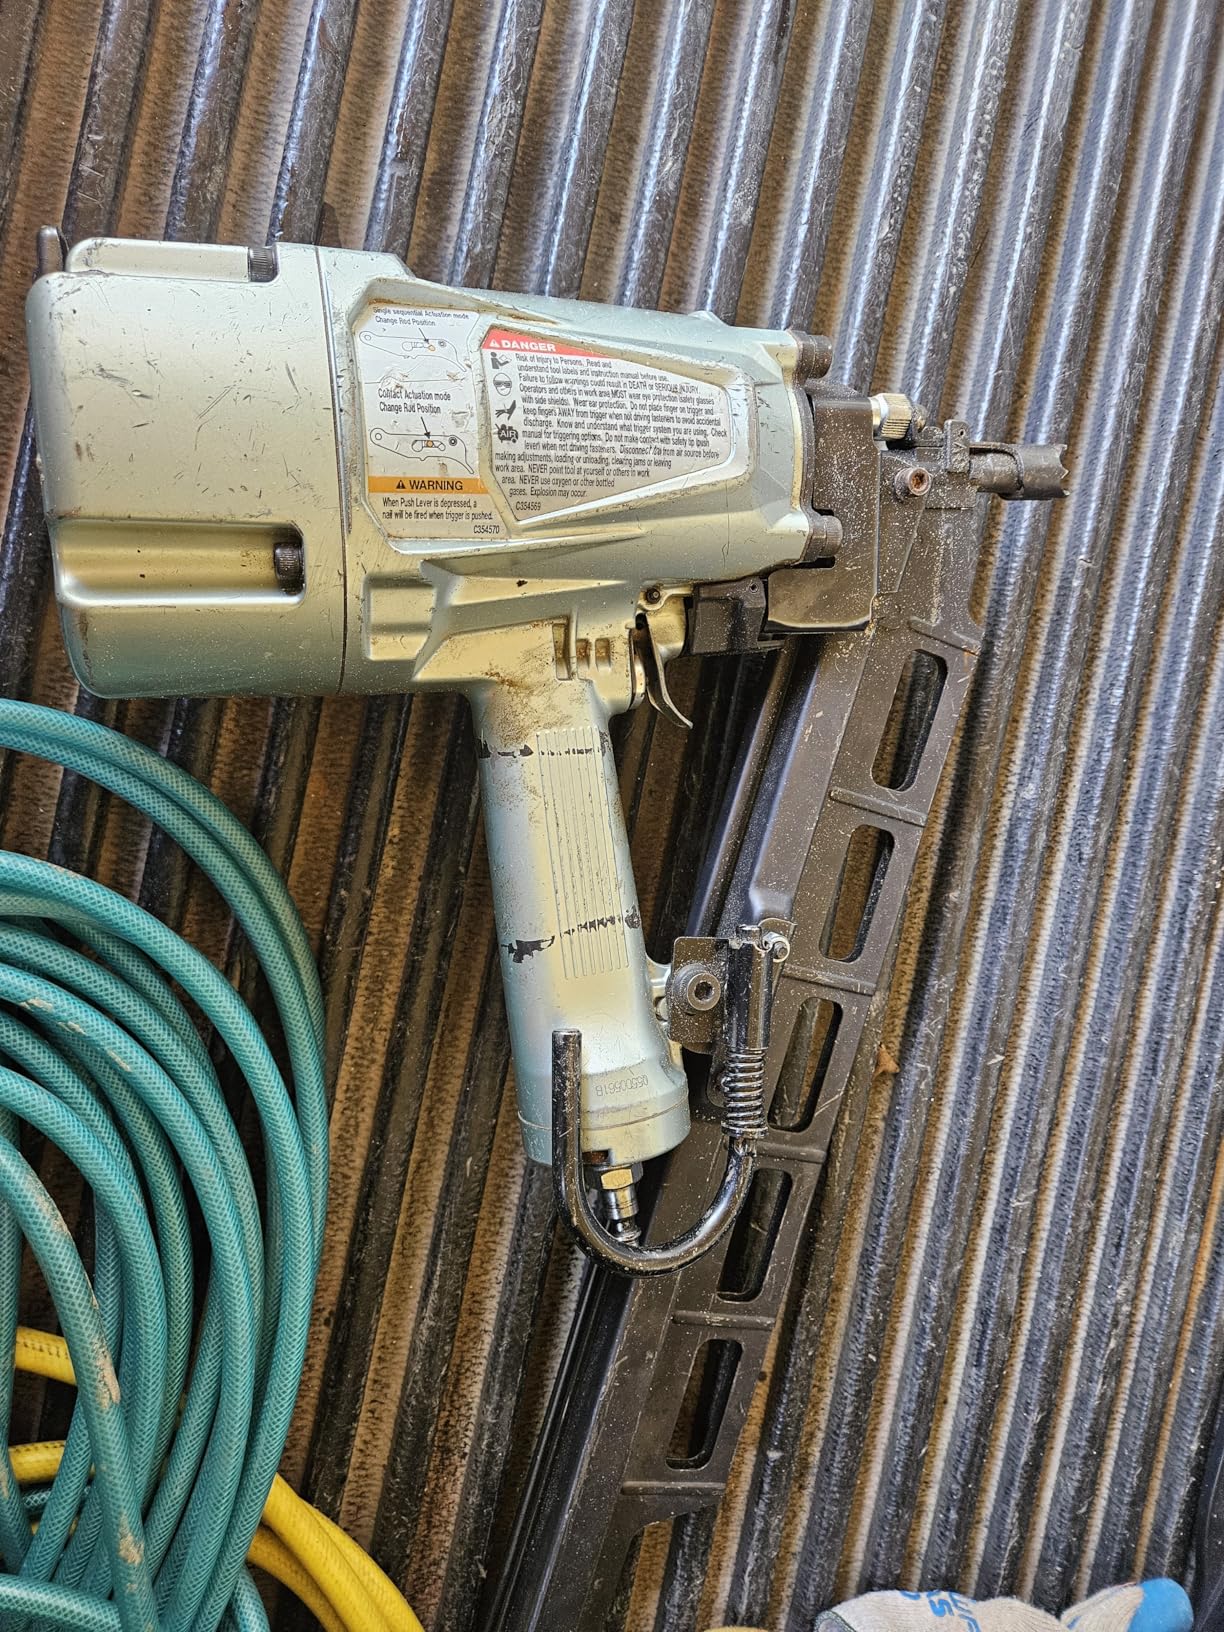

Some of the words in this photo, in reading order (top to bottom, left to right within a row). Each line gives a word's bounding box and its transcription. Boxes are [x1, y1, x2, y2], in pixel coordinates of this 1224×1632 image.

[373, 307, 391, 315] Single
[393, 309, 423, 317] sequential
[425, 310, 453, 318] Actuation
[375, 316, 397, 325] Change
[400, 317, 411, 325] Rod
[412, 318, 435, 326] Position
[501, 340, 556, 352] DANGER
[516, 353, 528, 361] Risk
[536, 354, 552, 364] Injury
[560, 357, 584, 366] Persons.
[586, 359, 600, 367] Read
[518, 365, 549, 373] understand
[550, 366, 560, 374] tool
[591, 370, 619, 378] instruction
[519, 373, 538, 382] Failure
[546, 375, 563, 384] follow
[564, 377, 589, 387] warnings
[590, 378, 605, 386] could
[606, 380, 622, 388] result
[629, 381, 647, 389] DEATH
[378, 388, 403, 399] Contact
[405, 390, 433, 400] Actuation
[434, 392, 451, 400] mode
[520, 383, 547, 394] Operators
[548, 385, 558, 393] and
[560, 386, 577, 395] others
[584, 388, 597, 396] work
[611, 389, 627, 399] MUST
[629, 392, 641, 400] wear
[642, 393, 651, 401] eye
[653, 392, 678, 402] protection
[696, 397, 714, 406] glasses
[379, 402, 402, 414] Change
[404, 403, 415, 413] Rod
[417, 403, 441, 414] Position
[522, 396, 534, 404] with
[535, 396, 546, 404] side
[573, 398, 589, 406] Wear
[599, 401, 628, 410] protection.
[649, 403, 662, 413] place
[664, 403, 678, 414] finger
[687, 405, 703, 416] trigger
[704, 407, 714, 415] and
[523, 405, 537, 415] keep
[538, 406, 556, 416] fingers
[558, 408, 574, 416] AWAY
[576, 409, 588, 417] from
[590, 410, 607, 421] trigger
[608, 411, 623, 420] when
[633, 412, 650, 424] driving
[652, 413, 674, 423] fasteners
[682, 416, 695, 424] avoid
[696, 417, 721, 426] accidental
[500, 430, 516, 438] AIR
[524, 418, 553, 429] discharge.
[557, 419, 573, 428] Know
[574, 421, 585, 429] and
[586, 421, 617, 430] understand
[620, 424, 632, 432] what
[634, 424, 651, 434] trigger
[653, 426, 671, 435] system
[673, 427, 682, 436] you
[693, 428, 709, 438] using.
[711, 428, 727, 437] Check
[522, 429, 543, 438] manual
[553, 430, 579, 442] triggering
[580, 432, 601, 442] options.
[614, 434, 623, 442] not
[624, 435, 638, 443] make
[640, 436, 659, 444] contact
[672, 437, 687, 448] safety
[542, 442, 558, 451] when
[559, 443, 568, 451] not
[570, 443, 588, 454] driving
[590, 444, 616, 453] fasteners.
[620, 445, 652, 454] Disconnect
[663, 447, 675, 456] from
[684, 450, 702, 458] source
[702, 450, 719, 459] before
[495, 452, 516, 463] making
[517, 452, 553, 463] adjustments,
[554, 454, 574, 465] loading
[583, 455, 610, 466] unloading,
[612, 456, 632, 467] clearing
[633, 458, 646, 467] jams
[654, 458, 671, 469] leaving
[495, 464, 509, 473] work
[528, 464, 547, 473] NEVER
[549, 465, 564, 475] point
[564, 466, 575, 474] tool
[583, 467, 605, 476] yourself
[613, 468, 630, 476] others
[637, 469, 650, 477] work
[409, 480, 463, 490] WARNING
[502, 476, 516, 484] area.
[519, 475, 539, 485] NEVER
[552, 479, 571, 488] oxygen
[580, 478, 595, 486] other
[596, 478, 615, 488] bottled
[509, 487, 527, 497] gases.
[530, 487, 558, 497] Explosion
[558, 490, 569, 498] may
[383, 497, 399, 507] When
[400, 498, 414, 507] Push
[416, 498, 433, 507] Lever
[434, 498, 439, 507] is
[440, 499, 472, 509] depressed,
[515, 501, 541, 511] C354569
[382, 510, 393, 519] nail
[394, 510, 403, 519] will
[405, 510, 412, 519] be
[414, 510, 428, 519] fired
[429, 510, 444, 519] when
[446, 510, 464, 521] trigger
[465, 511, 470, 519] is
[471, 512, 493, 520] pushed.
[474, 525, 500, 534] C354570
